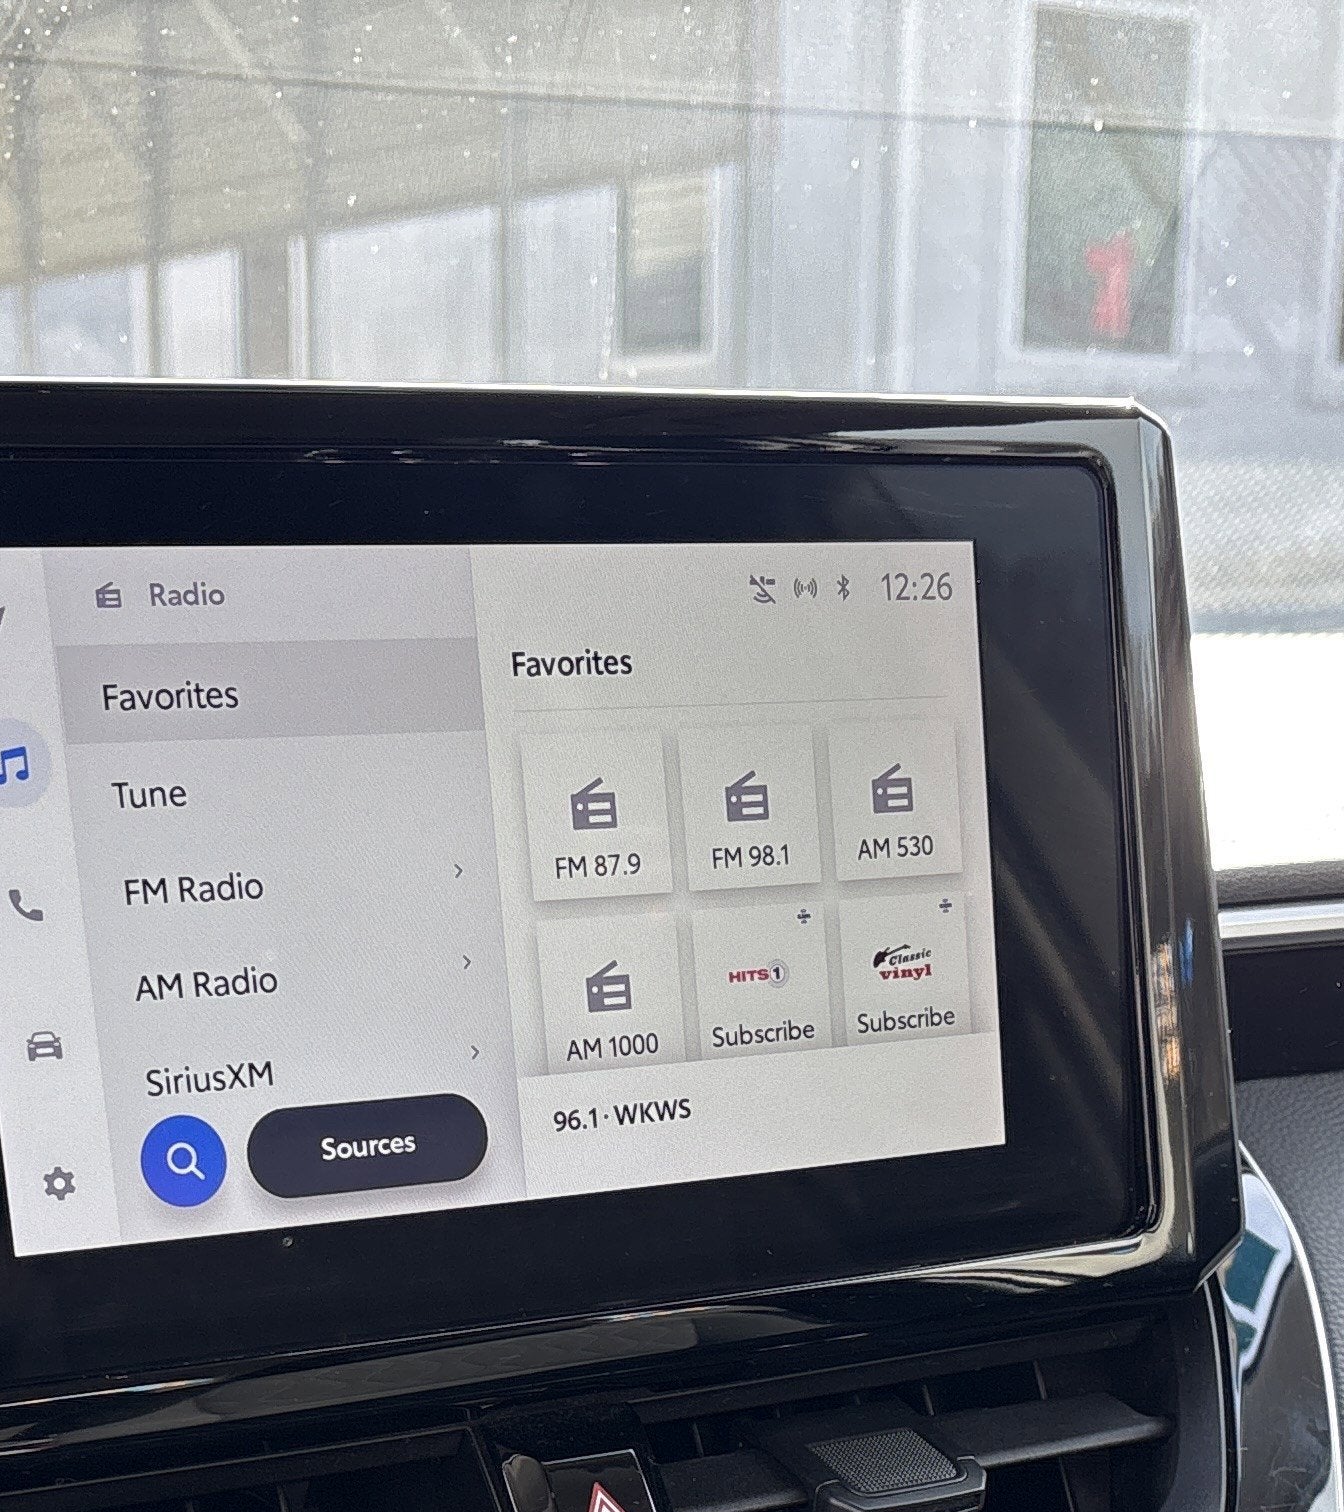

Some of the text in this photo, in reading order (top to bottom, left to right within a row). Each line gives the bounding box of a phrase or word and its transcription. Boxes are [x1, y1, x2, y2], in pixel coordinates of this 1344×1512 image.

[149, 582, 225, 608] Radio
[881, 572, 952, 601] 12:26
[511, 650, 632, 677] Favorites
[102, 682, 239, 712] Favorites
[112, 781, 187, 809] Tune
[712, 844, 790, 869] FM 98.1
[858, 835, 933, 860] AM 530
[555, 853, 641, 879] FM 87.9
[124, 871, 263, 905] FM Radio
[888, 948, 932, 966] Classic
[136, 968, 278, 1001] AM Radio
[712, 1019, 815, 1048] Subscribe
[857, 1006, 955, 1033] Subscribe
[567, 1033, 658, 1061] AM 1000
[146, 1062, 274, 1096] SiriusXM
[616, 1098, 691, 1125] WKWS
[321, 1132, 416, 1160] Sources
